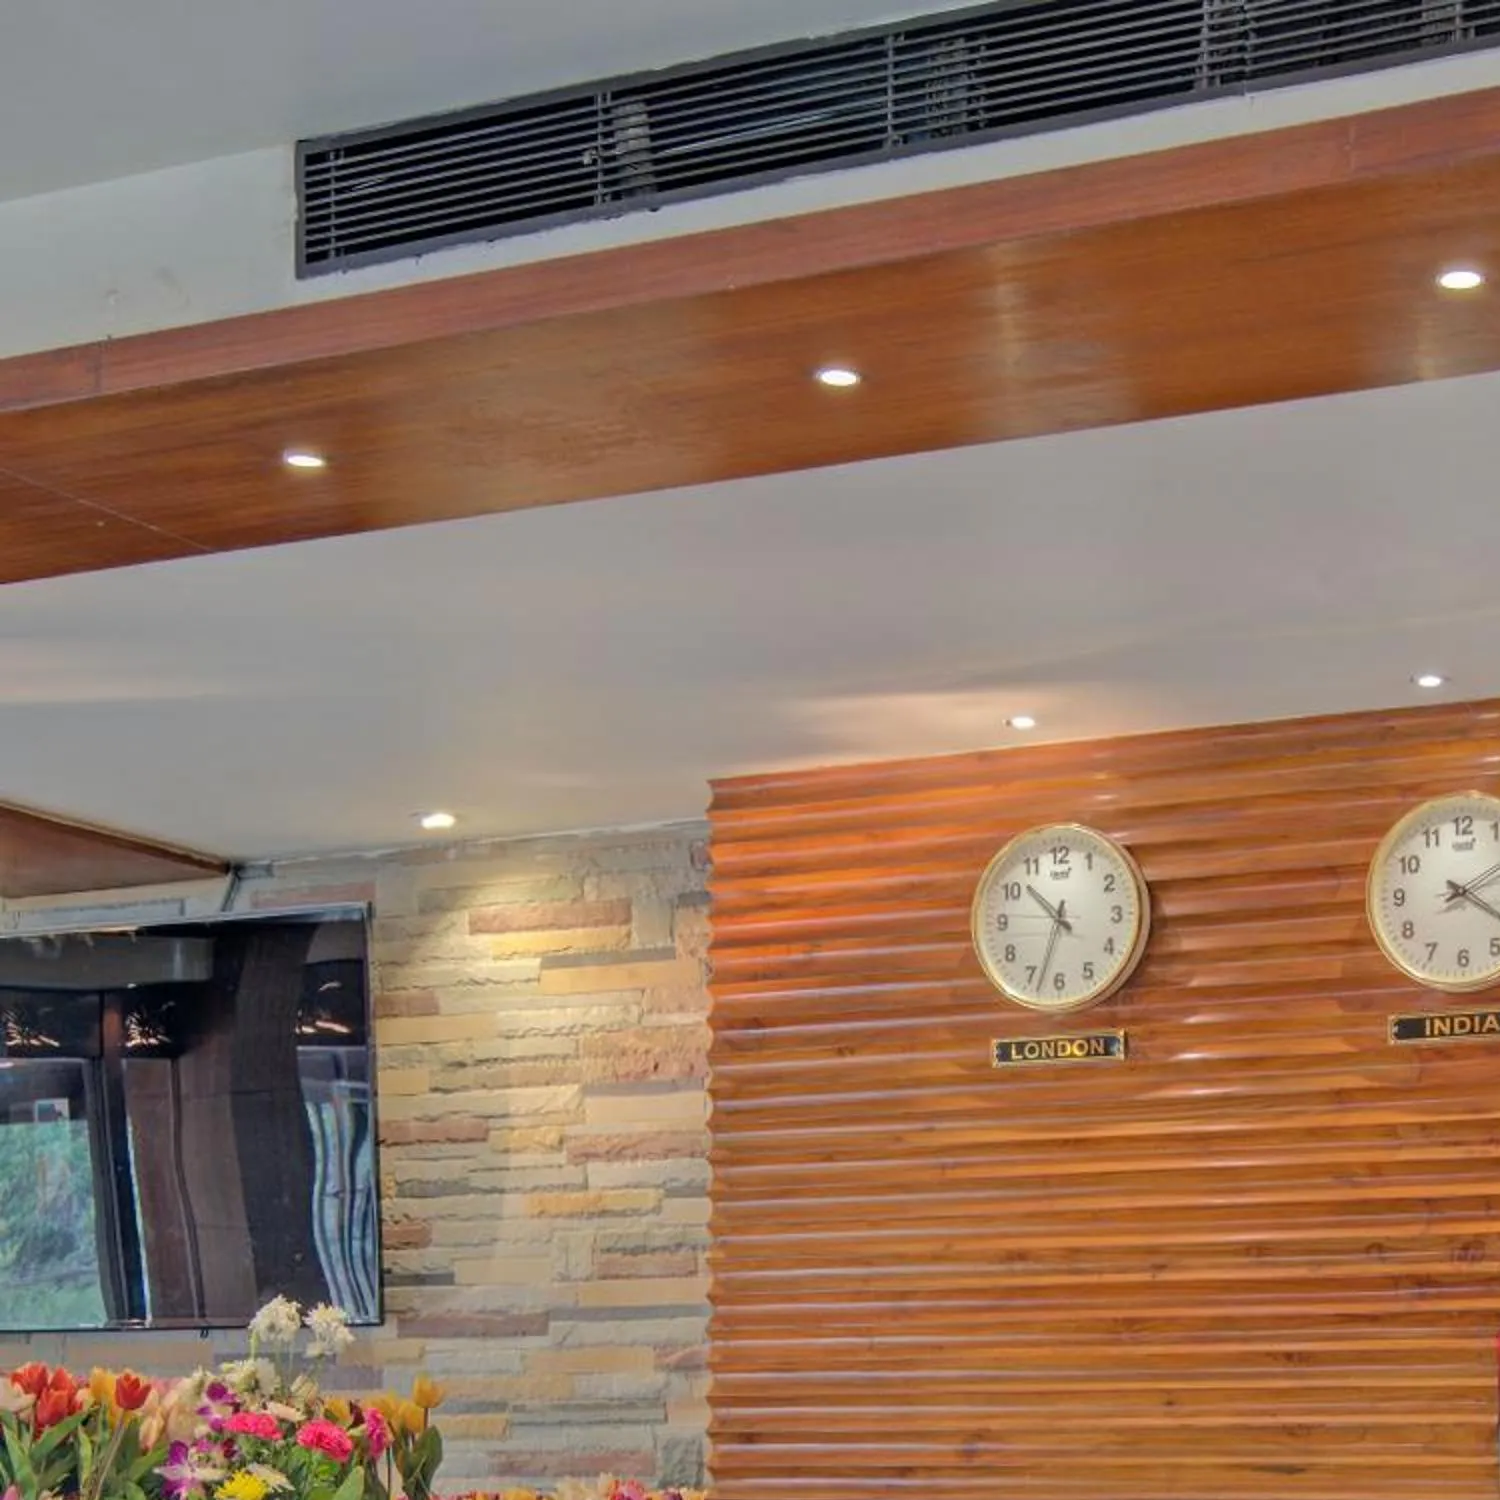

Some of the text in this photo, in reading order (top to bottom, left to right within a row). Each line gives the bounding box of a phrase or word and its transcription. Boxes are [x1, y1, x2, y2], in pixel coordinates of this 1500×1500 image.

[1454, 817, 1473, 835] 12
[1490, 823, 1499, 840] 1
[1423, 830, 1440, 847] 11
[1052, 846, 1070, 864] 12
[1085, 853, 1093, 870] 1
[1400, 855, 1419, 873] 10
[1024, 858, 1039, 875] 11
[1004, 882, 1021, 900] 10
[1104, 874, 1115, 892] 2
[1394, 888, 1405, 907] 9
[997, 914, 1007, 931] 9
[1111, 905, 1122, 923] 3
[1403, 921, 1414, 939] 8
[1005, 944, 1016, 962] 8
[1104, 938, 1114, 954] 4
[1425, 942, 1438, 961] 7
[1490, 938, 1500, 956] 5
[1457, 950, 1469, 967] 6
[1025, 966, 1037, 984] 7
[1083, 963, 1093, 979] 5
[1054, 973, 1064, 990] 6
[1425, 1015, 1500, 1036] INDIA
[1011, 1038, 1105, 1060] LONDON
